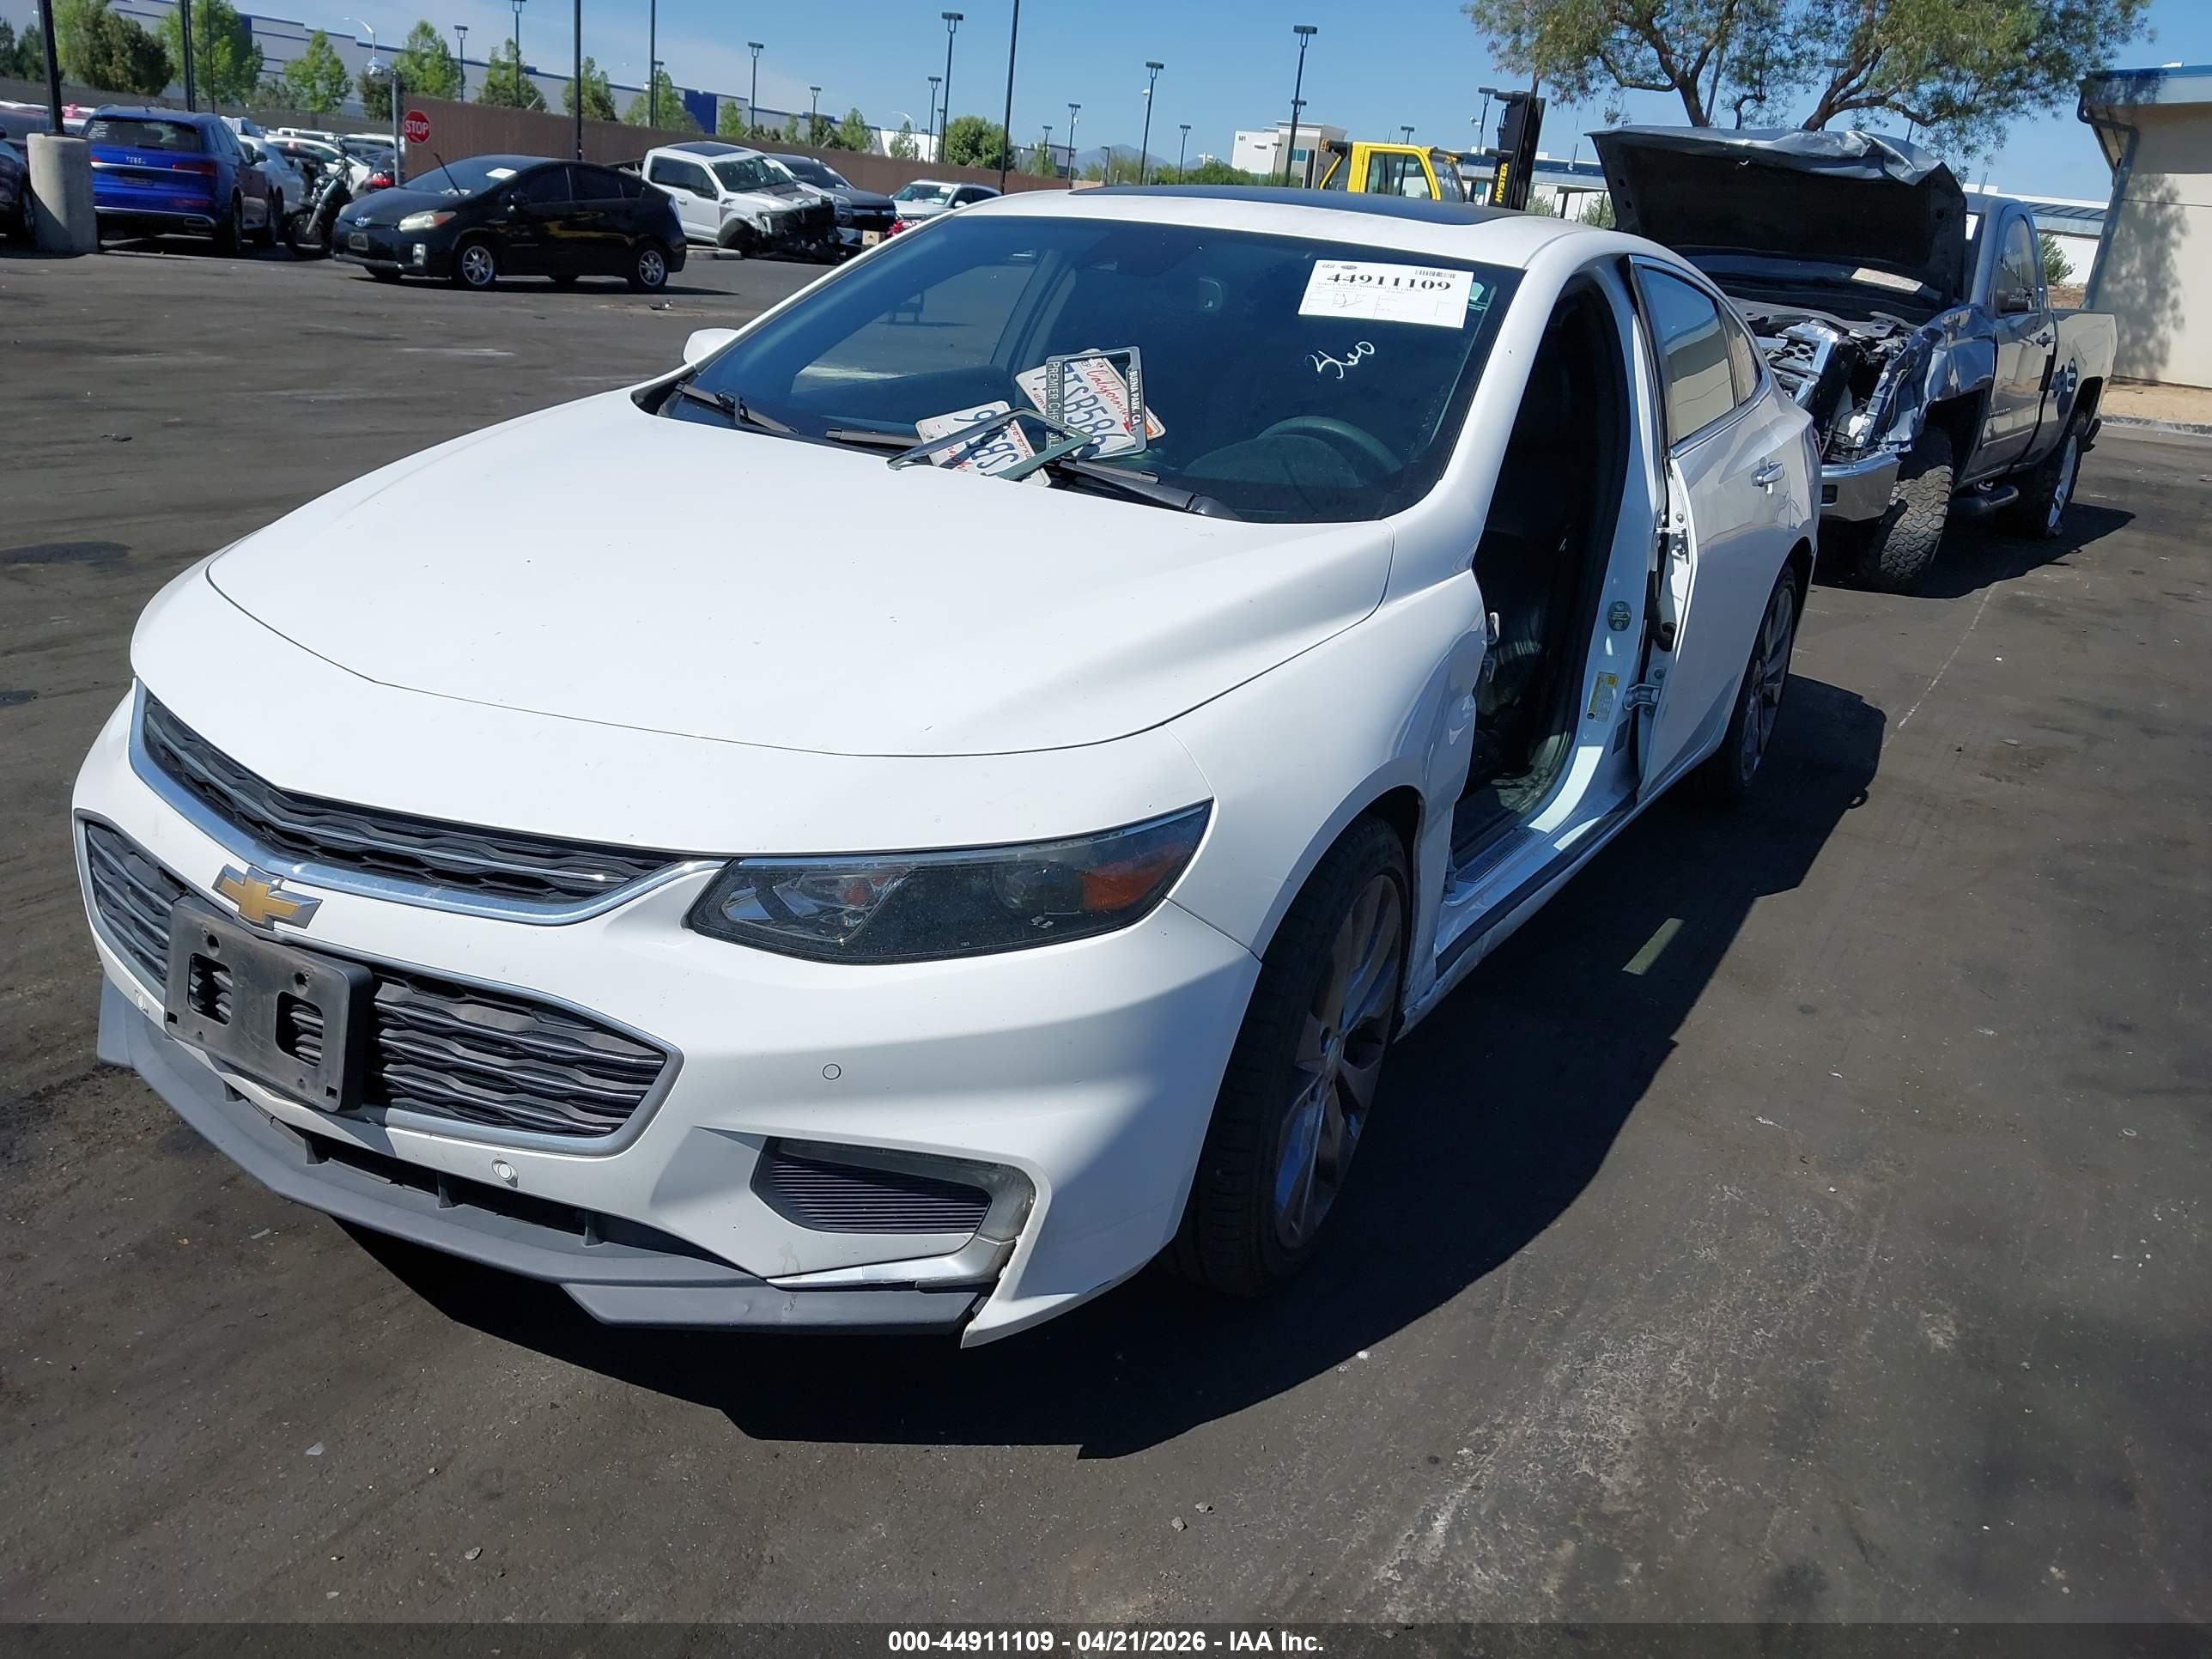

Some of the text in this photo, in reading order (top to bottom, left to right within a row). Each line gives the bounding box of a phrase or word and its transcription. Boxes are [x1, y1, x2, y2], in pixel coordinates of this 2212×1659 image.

[405, 120, 428, 135] STOP
[1495, 162, 1509, 203] HYSTER
[1327, 272, 1451, 291] 44911109
[1047, 361, 1060, 400] PREMIER
[1128, 370, 1139, 394] BUENA
[1131, 416, 1141, 425] CA
